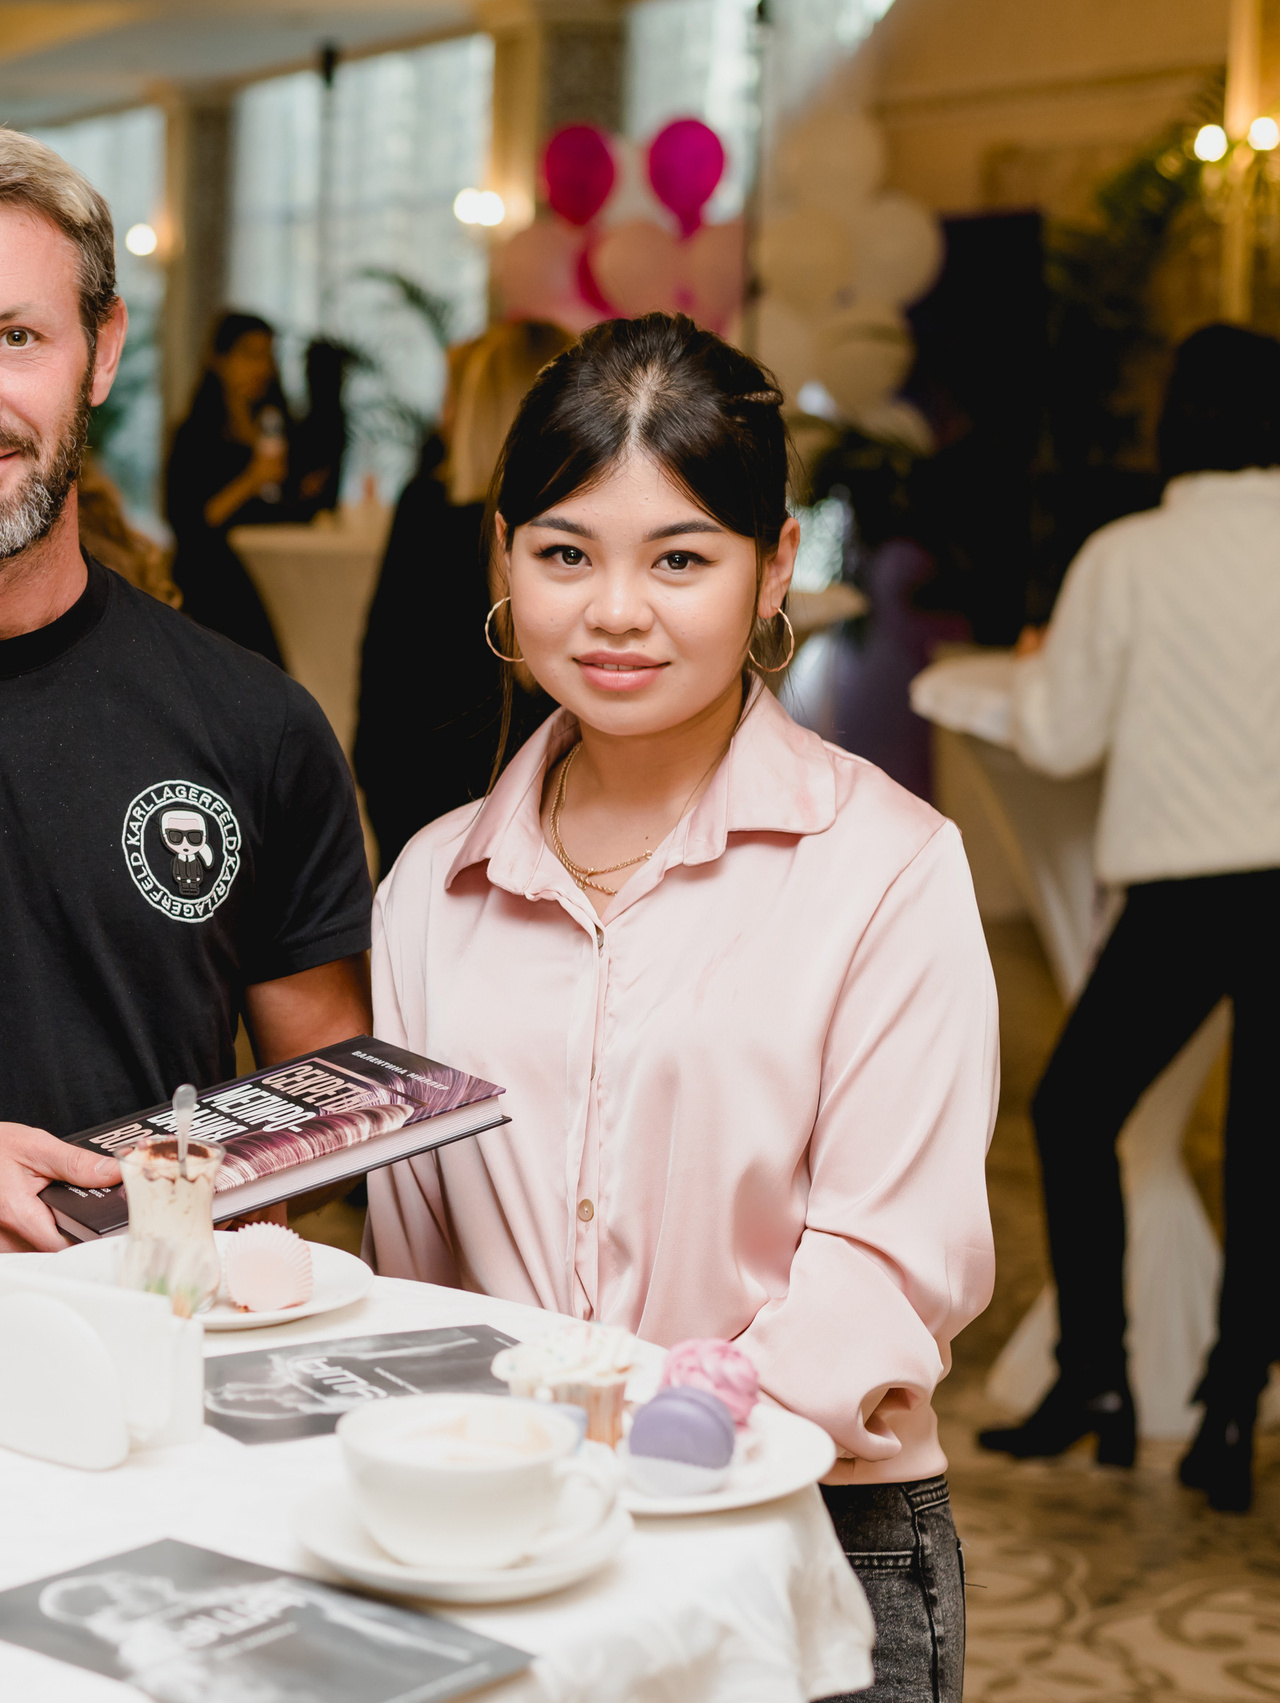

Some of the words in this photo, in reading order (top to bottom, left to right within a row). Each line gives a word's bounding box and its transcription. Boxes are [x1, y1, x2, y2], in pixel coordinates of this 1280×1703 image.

[127, 800, 154, 846] KARL
[151, 785, 237, 851] LAGERFELD
[130, 852, 214, 917] LAGERFELD
[213, 856, 236, 903] KARL
[351, 1050, 408, 1075] ВАЛЕНТИНА
[407, 1072, 450, 1091] МИЛЛЕР
[201, 1084, 317, 1133] МЕЛИРО-
